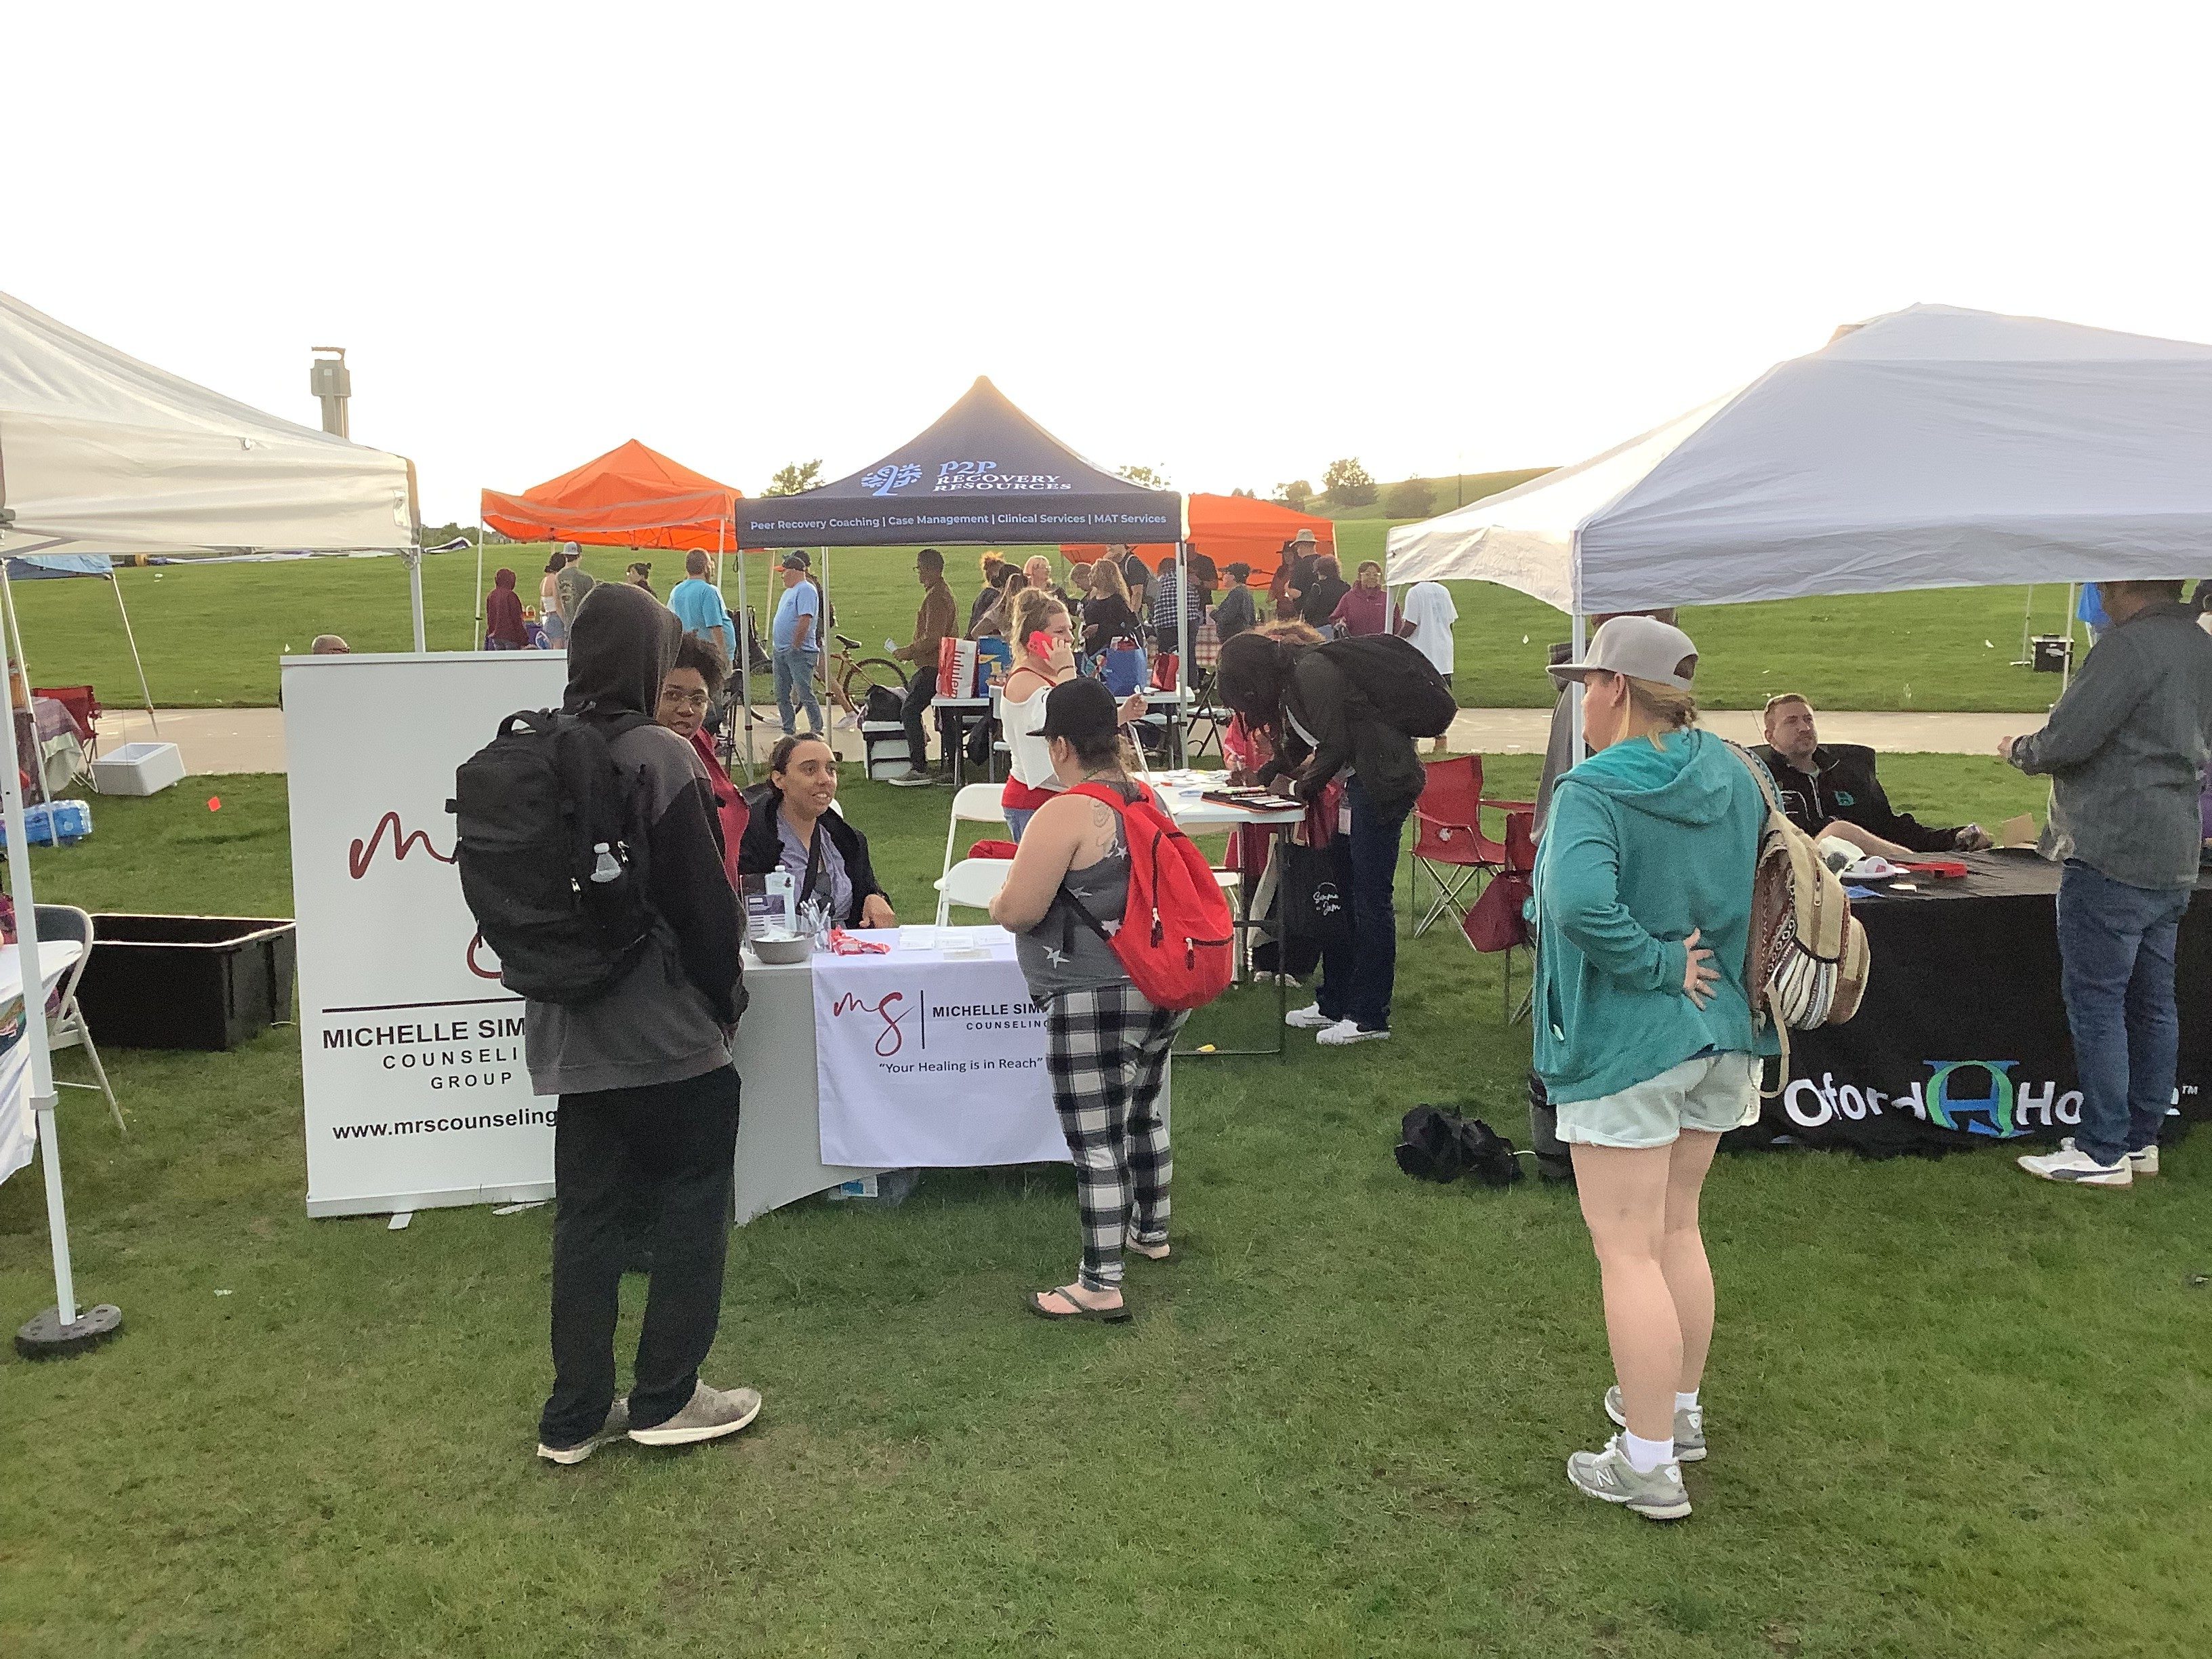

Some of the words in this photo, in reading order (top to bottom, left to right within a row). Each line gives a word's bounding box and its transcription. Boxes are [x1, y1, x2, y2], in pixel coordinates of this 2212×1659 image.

[937, 461, 997, 476] P2P
[933, 482, 1071, 491] RESOURCES
[936, 474, 1061, 485] RECOVERY
[750, 521, 775, 530] Peer
[778, 520, 827, 529] Recovery
[829, 517, 880, 528] Coaching
[888, 516, 914, 525] Case
[917, 515, 989, 526] Management
[998, 514, 1037, 523] Clinical
[1040, 514, 1086, 523] Services
[1094, 514, 1118, 523] MAT
[1121, 514, 1166, 523] Services
[951, 651, 965, 699] lululem
[933, 1004, 1008, 1017] MICHELLE
[1013, 1003, 1044, 1015] SIM
[323, 1021, 469, 1049] MICHELLE
[478, 1017, 525, 1038] SIM
[383, 1047, 517, 1069] COUNSELI
[919, 1061, 966, 1073] Healing
[970, 1060, 979, 1070] is
[984, 1059, 994, 1069] in
[431, 1071, 512, 1090] GROUP
[332, 1109, 558, 1140] www.mrscounseling
